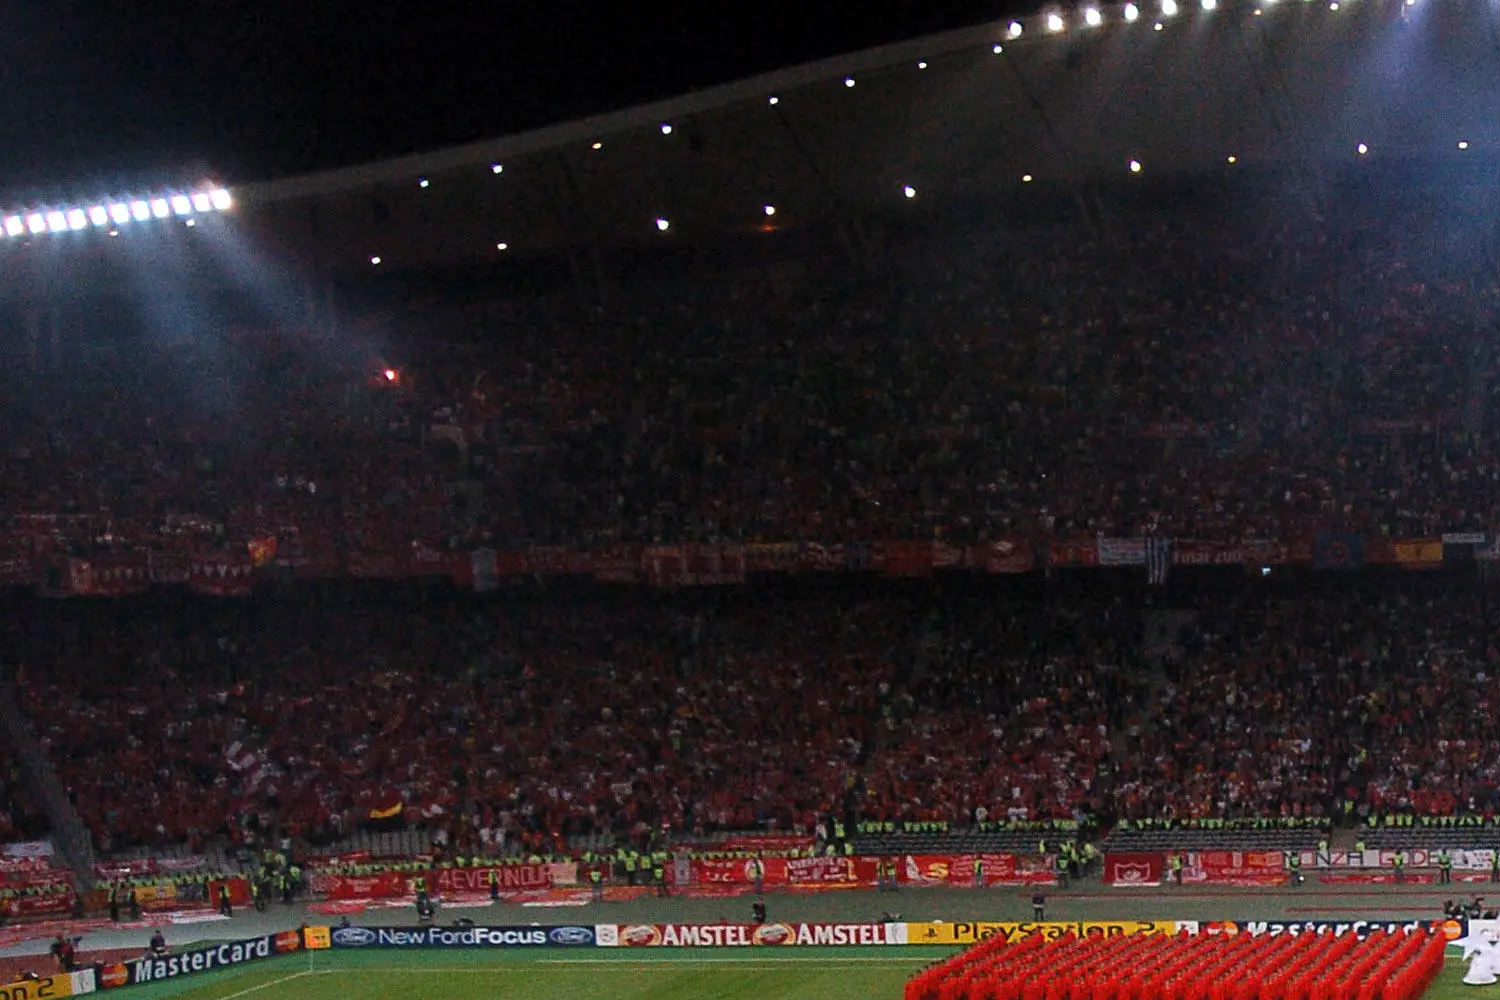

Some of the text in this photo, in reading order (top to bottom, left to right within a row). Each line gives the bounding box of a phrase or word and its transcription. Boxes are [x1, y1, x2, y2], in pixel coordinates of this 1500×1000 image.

[379, 928, 425, 945] New
[662, 924, 751, 946] AMSTEL
[796, 922, 885, 945] AMSTEL
[953, 923, 1124, 942] PlaySaion
[135, 936, 270, 984] MasterCard
[38, 978, 54, 998] 2
